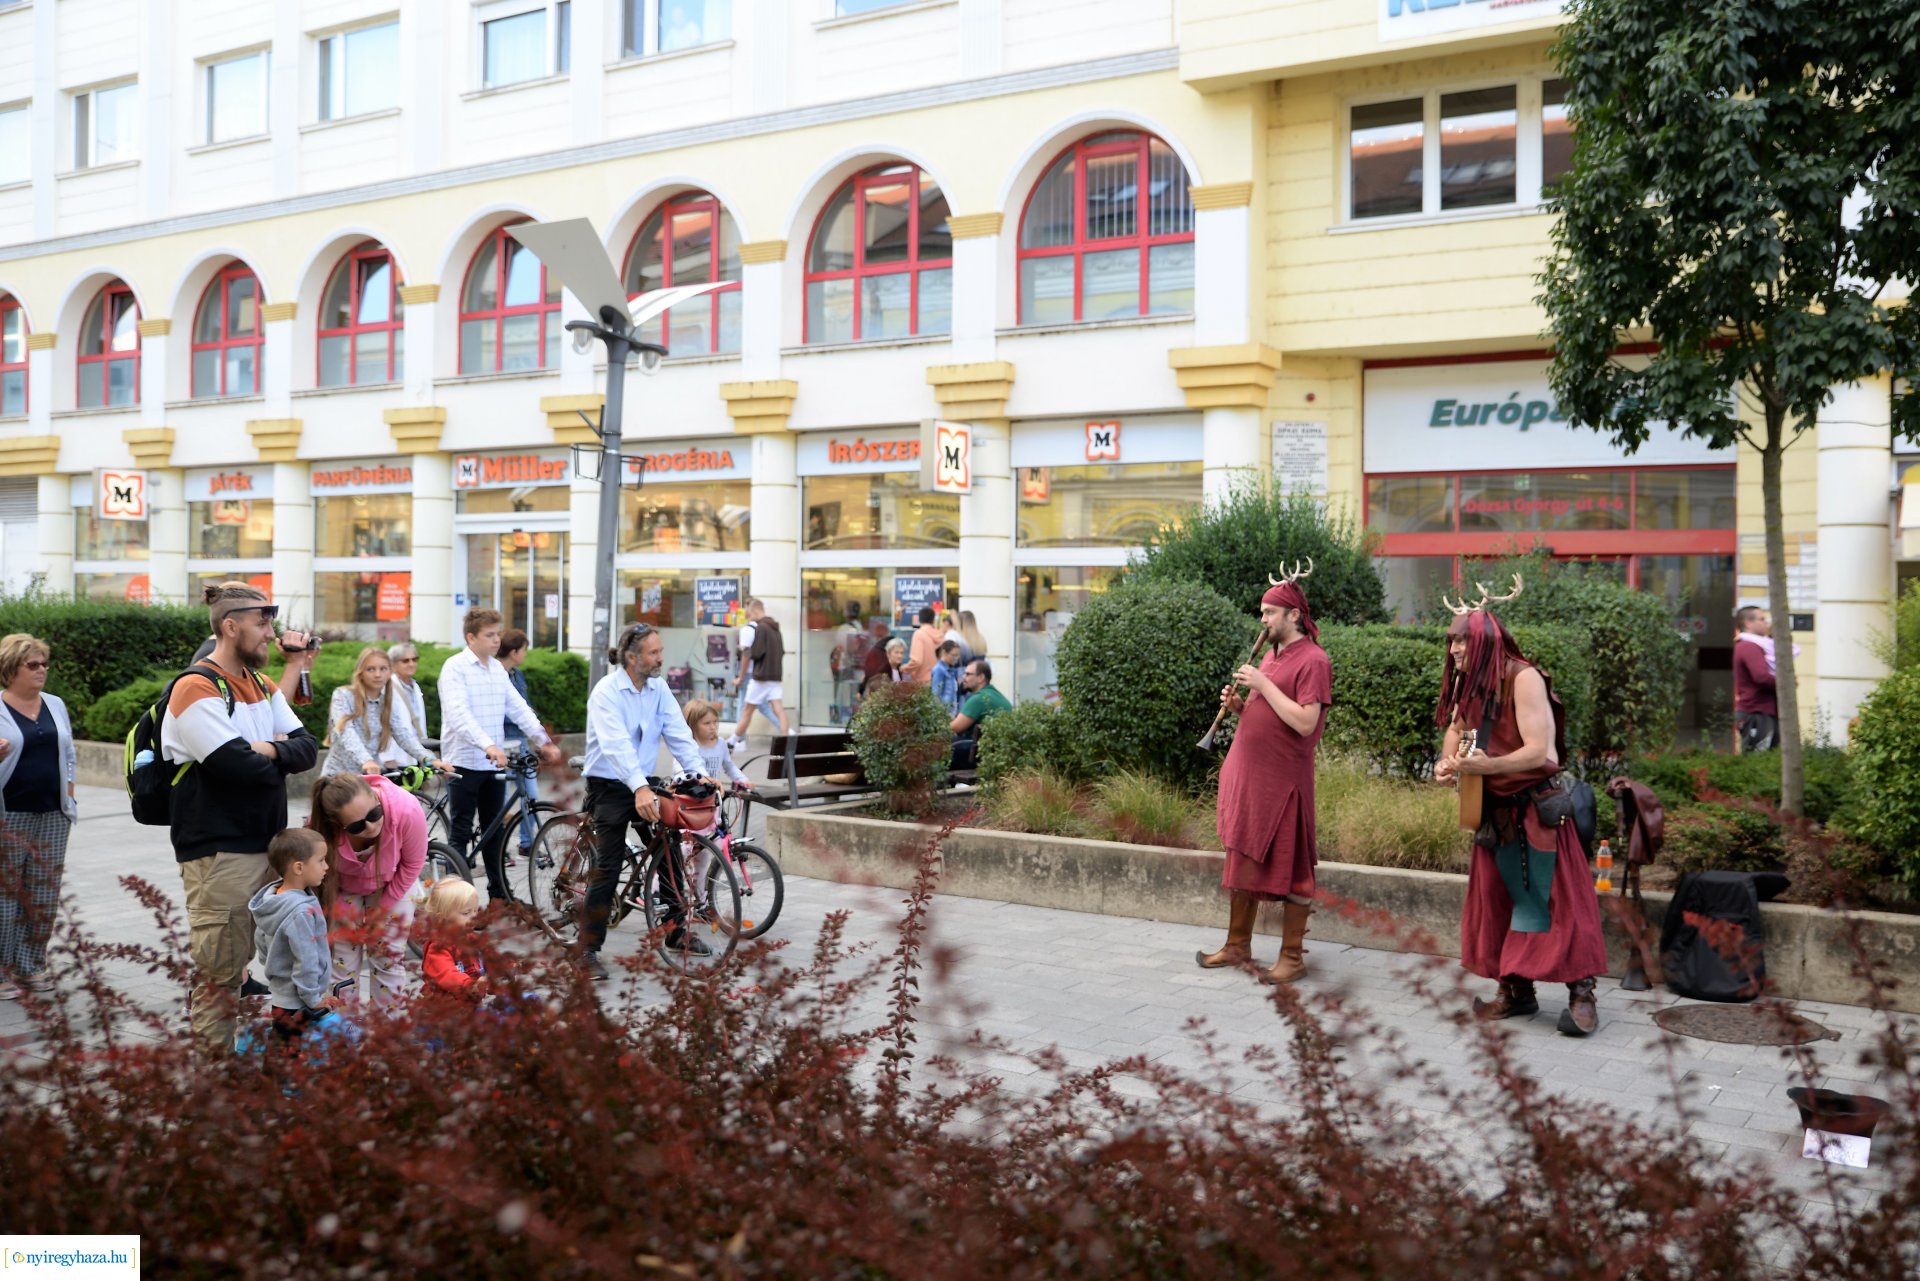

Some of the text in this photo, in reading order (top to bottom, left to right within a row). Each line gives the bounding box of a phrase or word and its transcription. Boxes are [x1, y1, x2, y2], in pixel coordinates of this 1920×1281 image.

[1094, 432, 1110, 447] M
[482, 455, 568, 482] Müller
[944, 446, 959, 470] M
[209, 471, 253, 495] JÁTÉK
[312, 464, 412, 487] PARFÜMÉRIA
[114, 486, 132, 503] M
